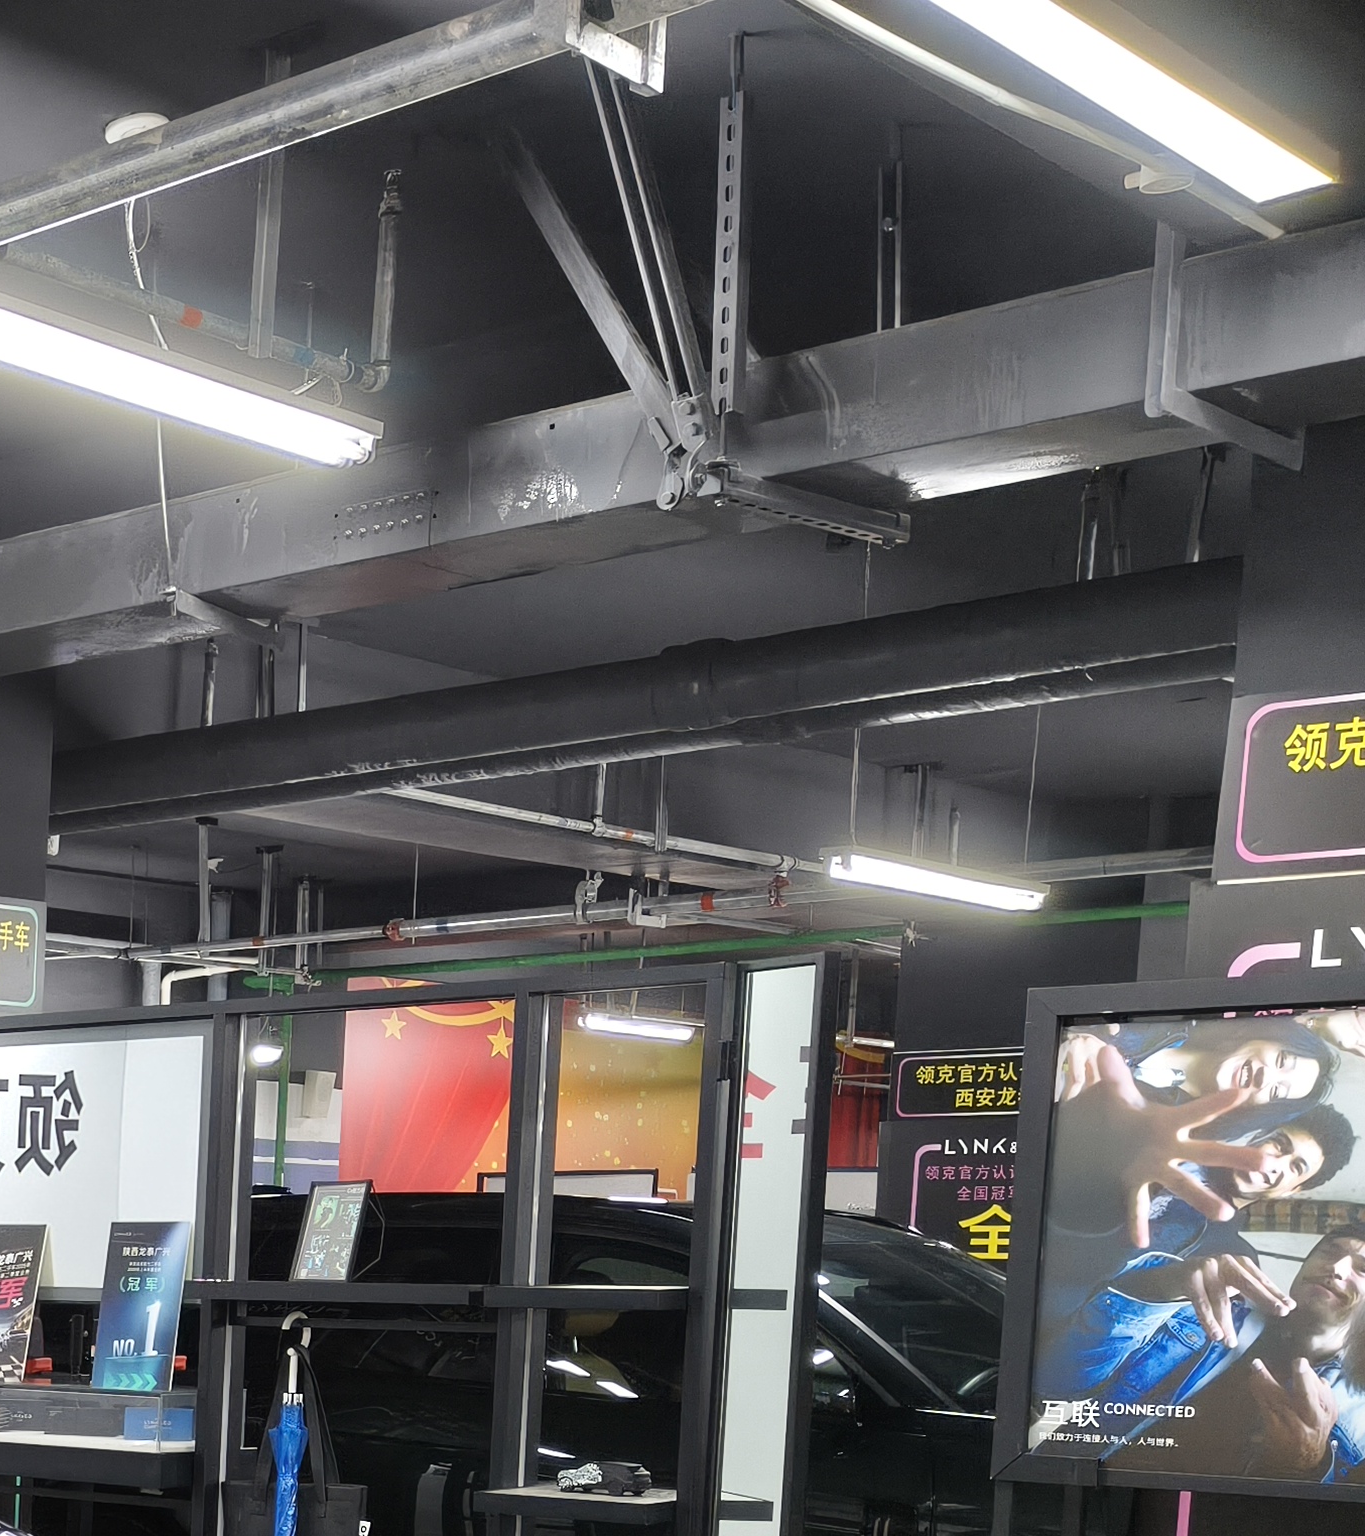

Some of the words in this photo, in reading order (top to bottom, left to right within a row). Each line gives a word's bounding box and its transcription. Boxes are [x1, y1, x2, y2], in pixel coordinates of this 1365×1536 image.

[915, 1062, 1024, 1085] 领克官方认
[954, 1086, 1022, 1108] 西安龙
[1039, 1398, 1101, 1429] 互联
[1103, 1402, 1196, 1419] CONNECTED
